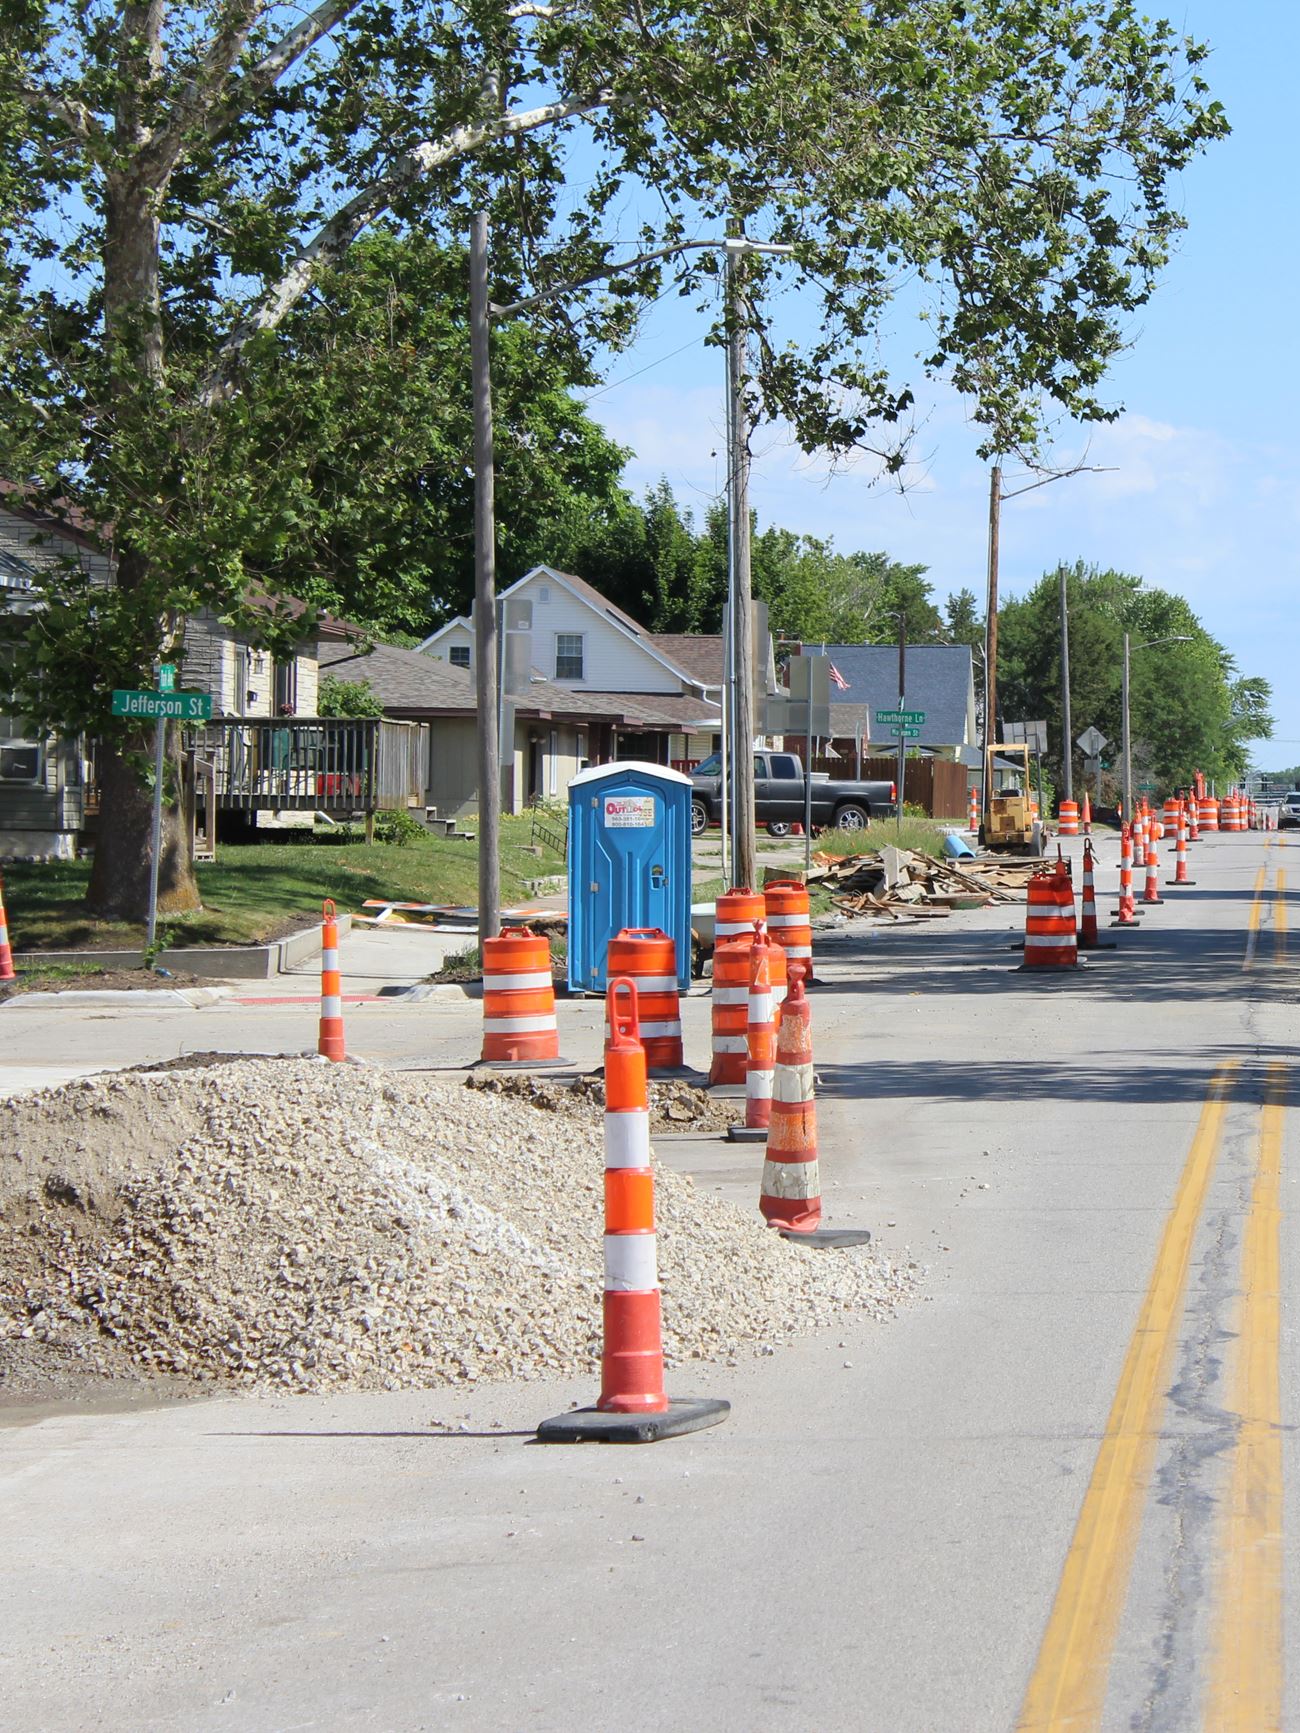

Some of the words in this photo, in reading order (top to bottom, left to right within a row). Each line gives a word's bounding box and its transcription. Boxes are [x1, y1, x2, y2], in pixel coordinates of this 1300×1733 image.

[121, 694, 182, 715] Jefferson
[188, 697, 203, 715] St
[877, 713, 912, 723] Hawthorne
[915, 713, 923, 723] Ln
